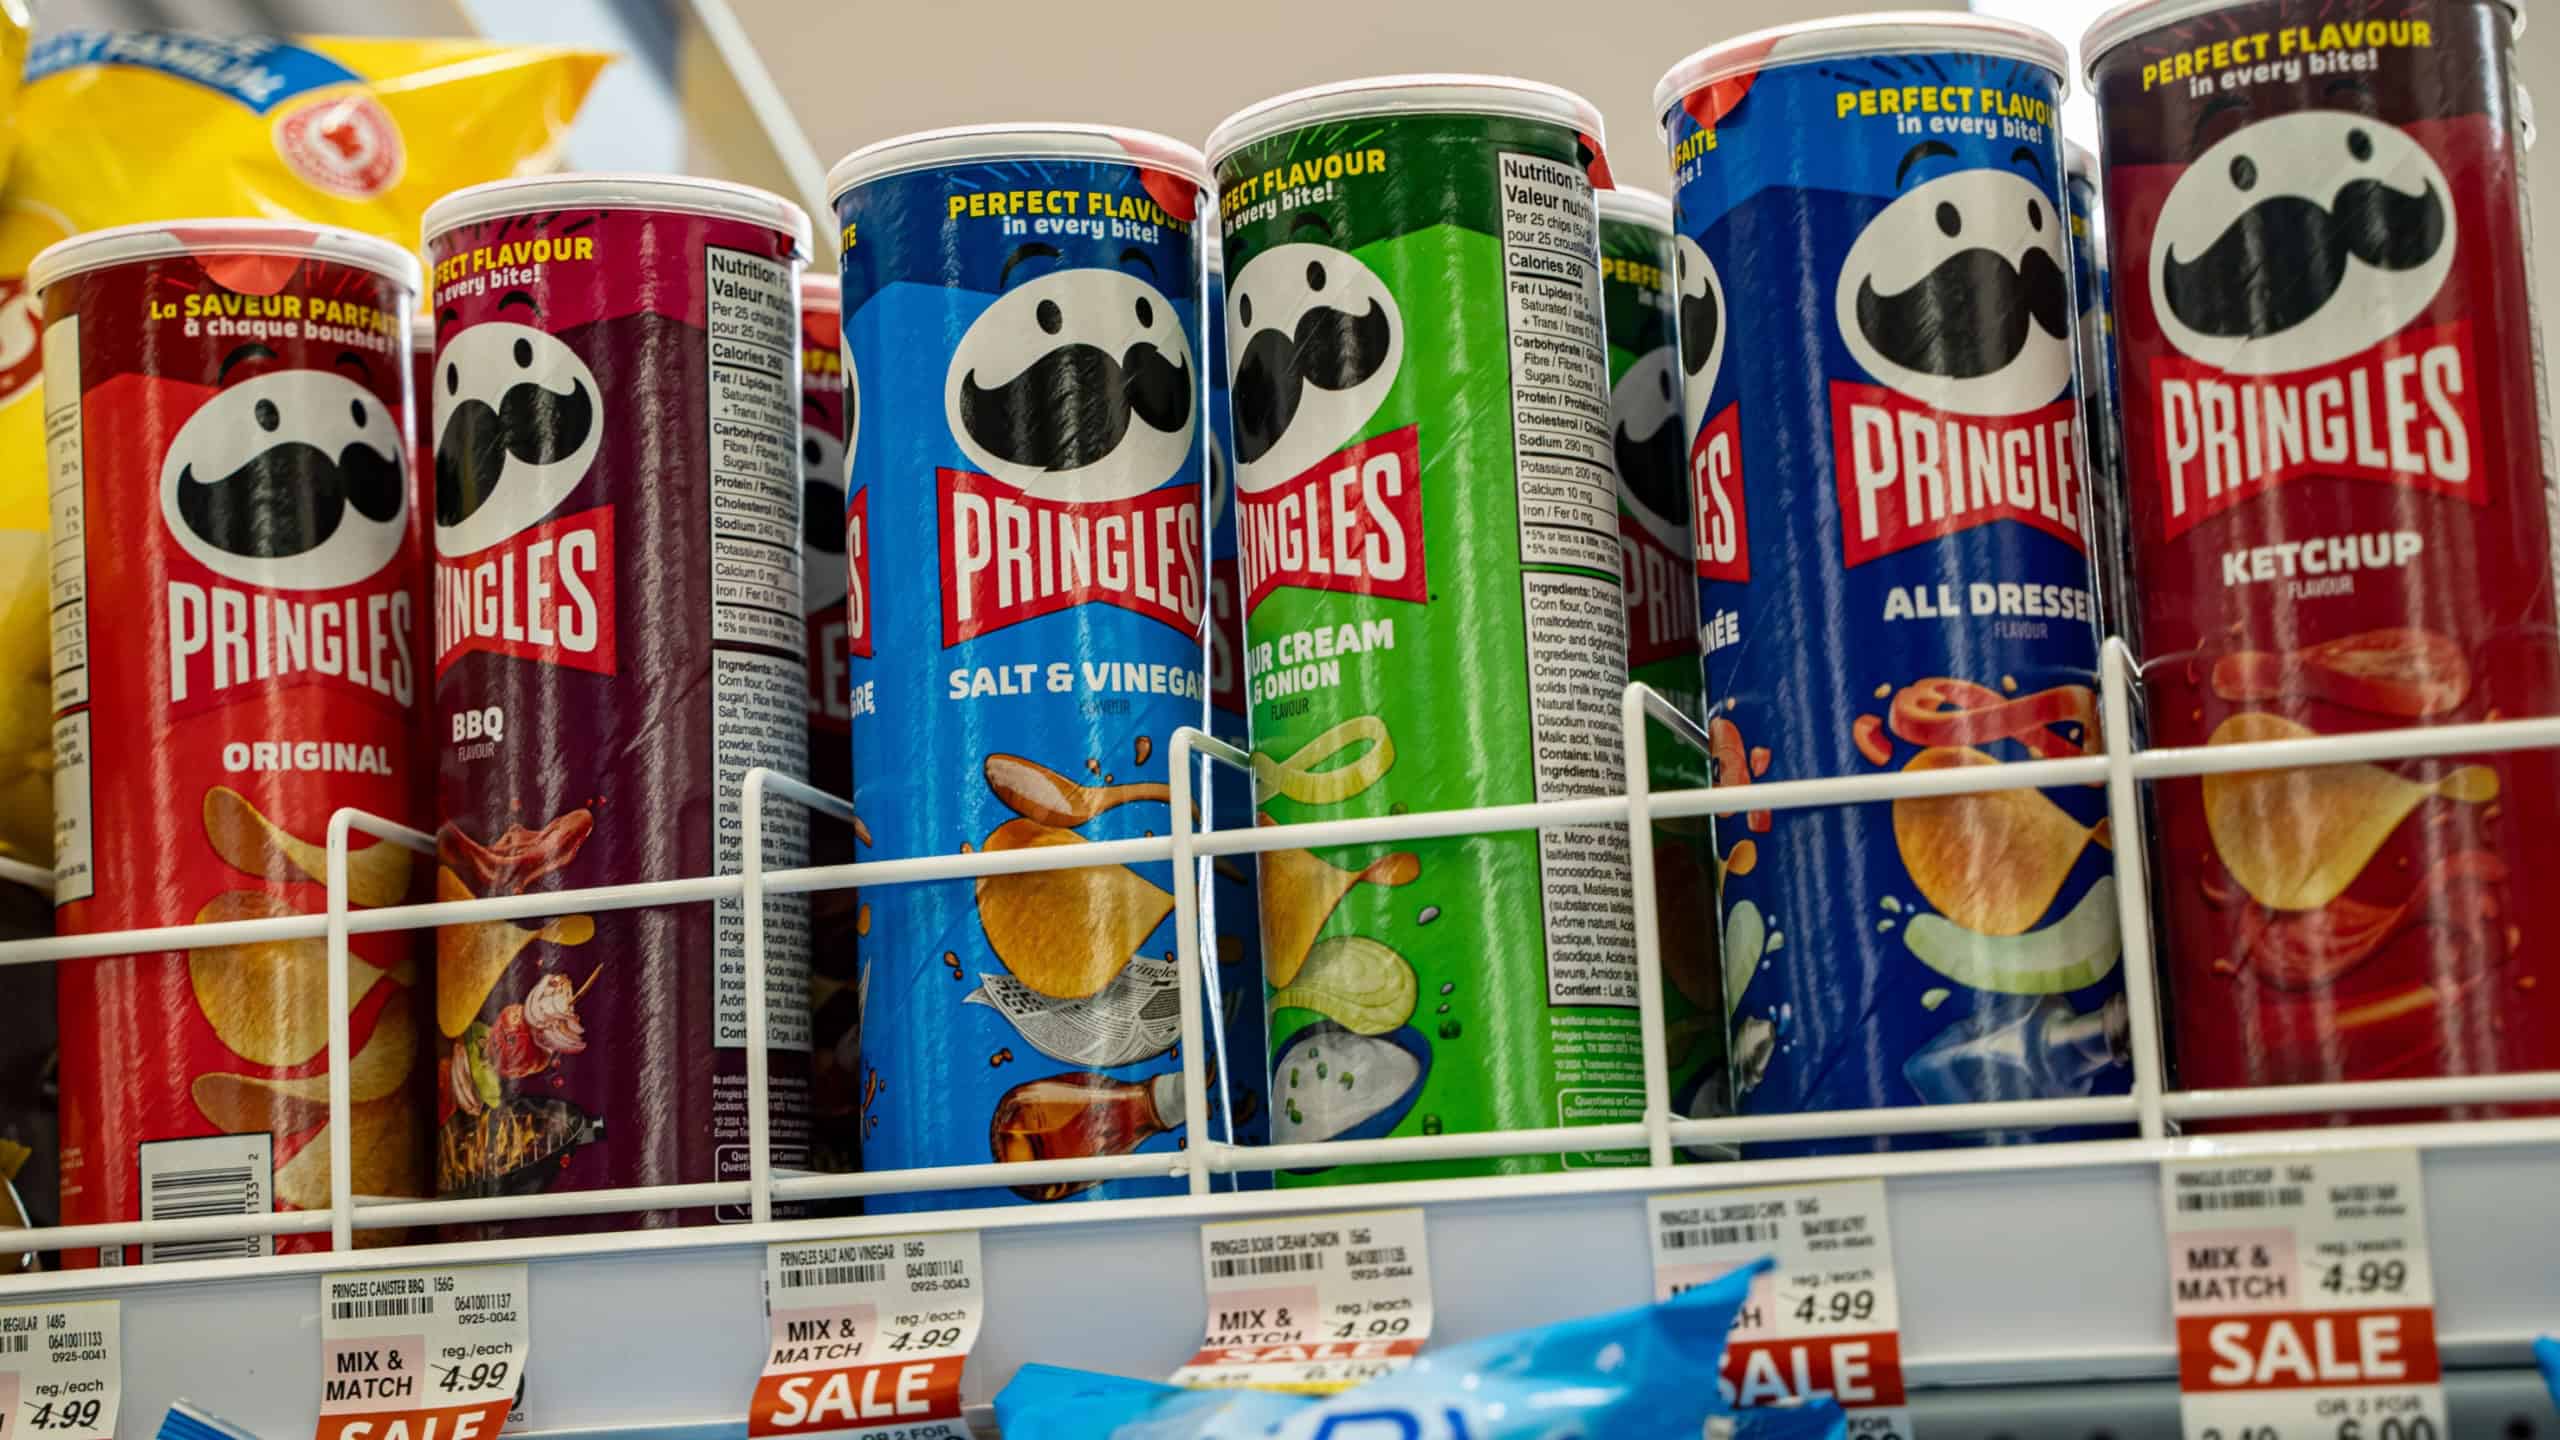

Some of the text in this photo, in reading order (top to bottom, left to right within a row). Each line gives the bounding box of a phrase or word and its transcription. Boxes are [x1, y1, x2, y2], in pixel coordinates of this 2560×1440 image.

[2142, 20, 2432, 92] PERFECT FLAVOUR
[2190, 50, 2378, 99] in every bite!
[1837, 87, 2057, 129] PERFECT FLAVOU
[1897, 115, 2042, 144] in every bite!
[1671, 127, 1718, 172] FAITE
[1264, 149, 1386, 196] FLAVOUR
[1504, 159, 1573, 190] Nutrition
[950, 190, 1079, 219] PERFECT
[1235, 180, 1333, 230] every bite!
[1506, 184, 1559, 210] Valeur
[1003, 215, 1159, 245] in every bite!
[1507, 209, 1572, 236] Per 25 chips
[1508, 230, 1551, 245] pour 25
[473, 237, 593, 273] FLAVOUR
[1509, 253, 1564, 273] Calories
[712, 254, 777, 286] Nutrition
[445, 263, 541, 302] every bite!
[712, 278, 763, 304] Valeur
[1511, 281, 1573, 301] Fat Lipides
[151, 301, 177, 320] La
[184, 294, 301, 318] SAVEUR
[712, 302, 748, 320] Per 25
[1521, 298, 1567, 315] Saturated
[184, 317, 199, 338] à
[207, 317, 298, 340] chaque
[712, 322, 738, 334] pour
[1532, 316, 1558, 330] Trans
[712, 344, 764, 365] Calories
[1514, 336, 1580, 356] Carbohydrate
[1524, 352, 1550, 367] Fibre
[713, 371, 730, 384] Fat
[1525, 369, 1560, 385] Sugars
[1517, 391, 1557, 405] Protein
[1518, 412, 1578, 430] Cholesterol
[2161, 345, 2470, 518] PRINGLES
[1520, 433, 1562, 448] Sodium
[1521, 460, 1573, 475] Potassium
[715, 475, 752, 490] Protein
[1522, 482, 1577, 497] Calcium 10
[1524, 504, 1570, 519] Iron Fer
[715, 517, 756, 535] Sodium
[953, 491, 1200, 623] PRINGLES
[2222, 531, 2423, 587] KETCHUP
[716, 563, 756, 579] Calcium
[716, 583, 736, 597] Iron
[1529, 581, 1592, 596] Ingredients:
[2288, 574, 2354, 599] FLAVOUR
[1882, 586, 1960, 621] ALL
[1278, 619, 1395, 667] CREAM
[1994, 622, 2049, 640] FLAVOUR
[168, 579, 413, 708] PRINGLES
[950, 664, 1037, 700] SALT
[1046, 663, 1074, 694] &
[1265, 660, 1340, 700] ONION
[1534, 664, 1567, 676] Onion
[1271, 697, 1310, 721] FLAVOUR
[1537, 697, 1574, 710] Natural
[452, 706, 504, 743] BBQ
[1538, 714, 1585, 728] Disodium
[222, 741, 392, 776] ORIGINAL
[458, 742, 496, 762] FLAVOUR
[780, 1250, 818, 1267] PRINGLES
[819, 1248, 838, 1264] SALT
[838, 1246, 857, 1262] AND
[859, 1243, 895, 1261] VINEGAR
[2187, 1245, 2270, 1271] MIX &
[332, 1282, 368, 1298] PRINGLES
[370, 1279, 407, 1297] CANISTER
[408, 1278, 425, 1294] BBQ
[911, 1278, 970, 1292] 0925-0043
[2178, 1275, 2287, 1301] MATCH
[2321, 1260, 2407, 1293] 4.99
[458, 1311, 517, 1325] 0925-0042
[895, 1310, 966, 1327] reg./each
[1220, 1307, 1292, 1331] MIX &
[1336, 1299, 1412, 1315] reg./each
[1793, 1290, 1875, 1324] 4.99
[4, 1315, 38, 1332] REGULAR
[788, 1318, 856, 1343] MIX &
[889, 1327, 961, 1352] 4.99
[1205, 1331, 1303, 1346] MATCH
[2208, 1316, 2406, 1385] SALE
[52, 1349, 107, 1363] 0925-0041
[336, 1350, 403, 1373] MIX &
[442, 1343, 513, 1360] reg./each
[772, 1342, 863, 1365] MATCH
[36, 1379, 104, 1397] reg./each
[326, 1376, 413, 1401] MATCH
[440, 1361, 509, 1392] 4.99
[770, 1363, 935, 1427] SALE
[30, 1399, 101, 1430] 4.99
[2338, 1416, 2438, 1440] 600
